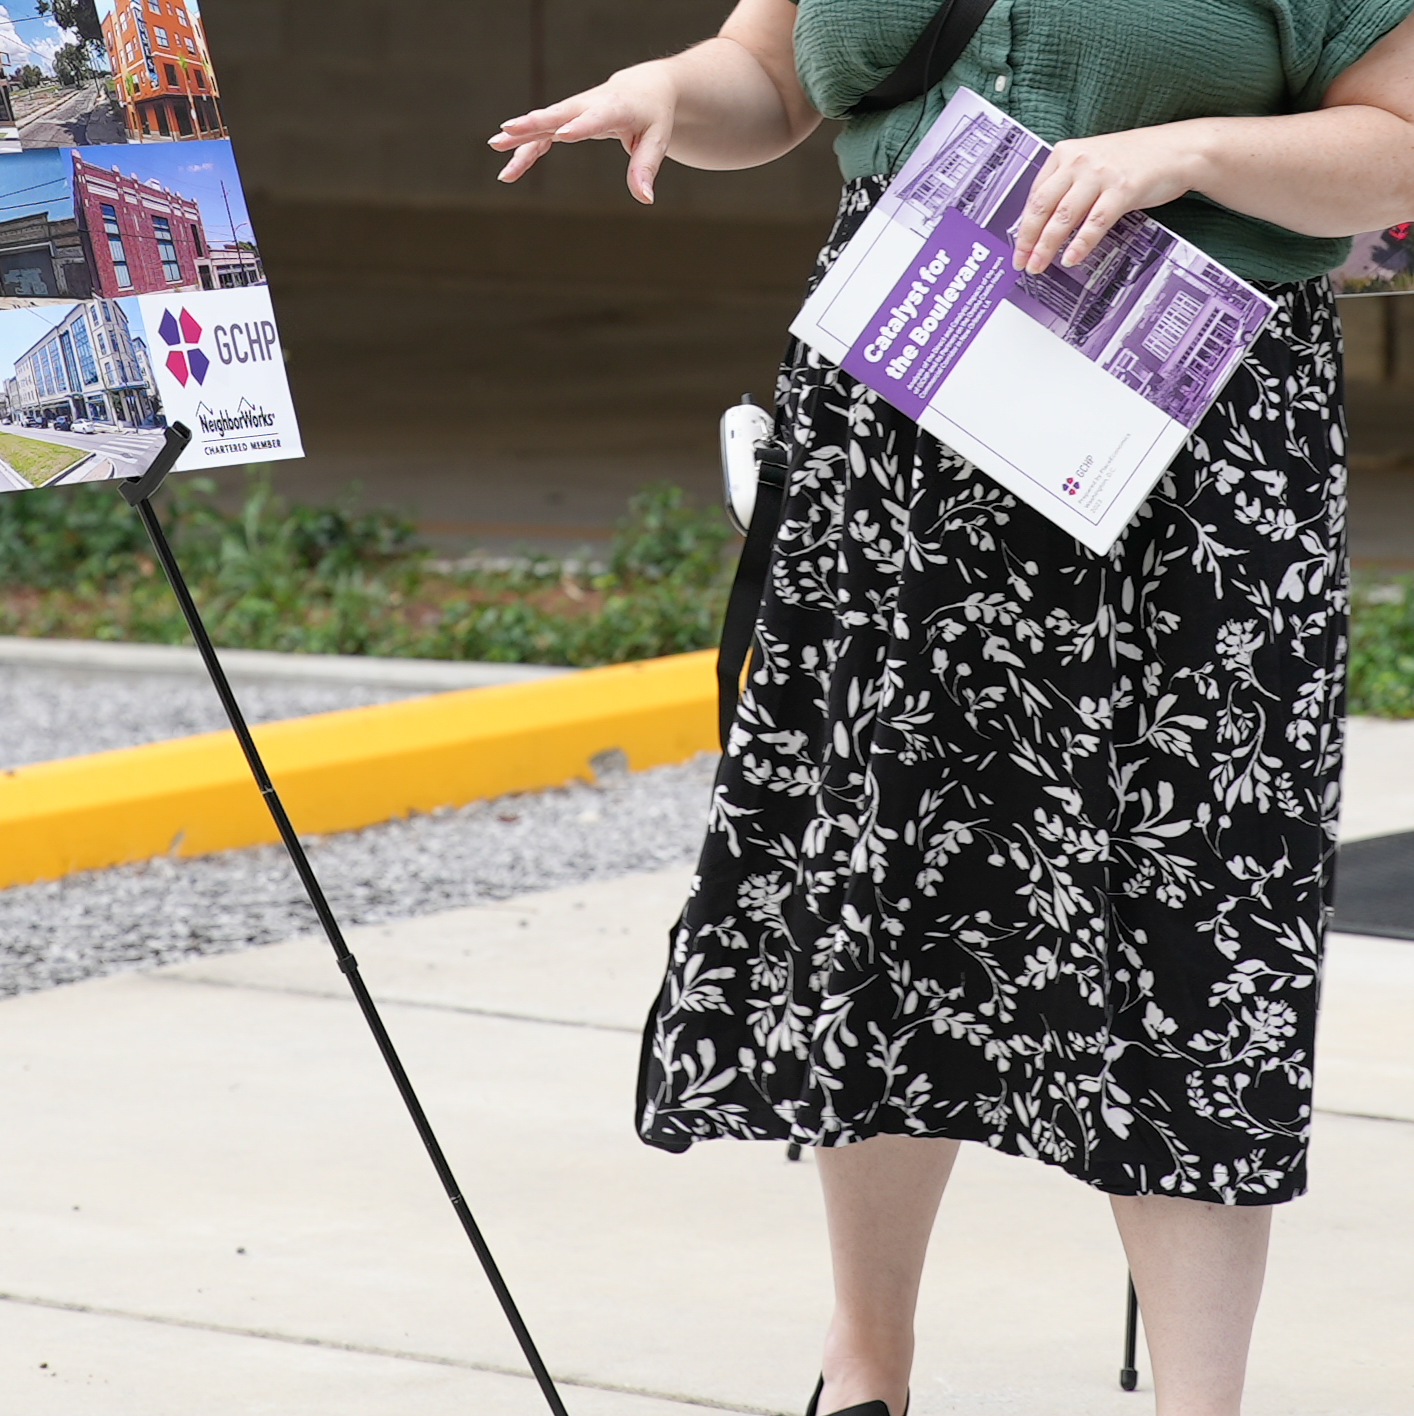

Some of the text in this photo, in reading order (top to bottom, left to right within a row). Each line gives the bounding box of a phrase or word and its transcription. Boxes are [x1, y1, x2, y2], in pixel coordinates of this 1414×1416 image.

[864, 250, 950, 362] Catalyst for
[885, 242, 990, 379] the Boulevard
[214, 320, 276, 365] GCHP
[204, 439, 282, 456] CHARTERED MEMBER
[1076, 455, 1094, 477] GCHP
